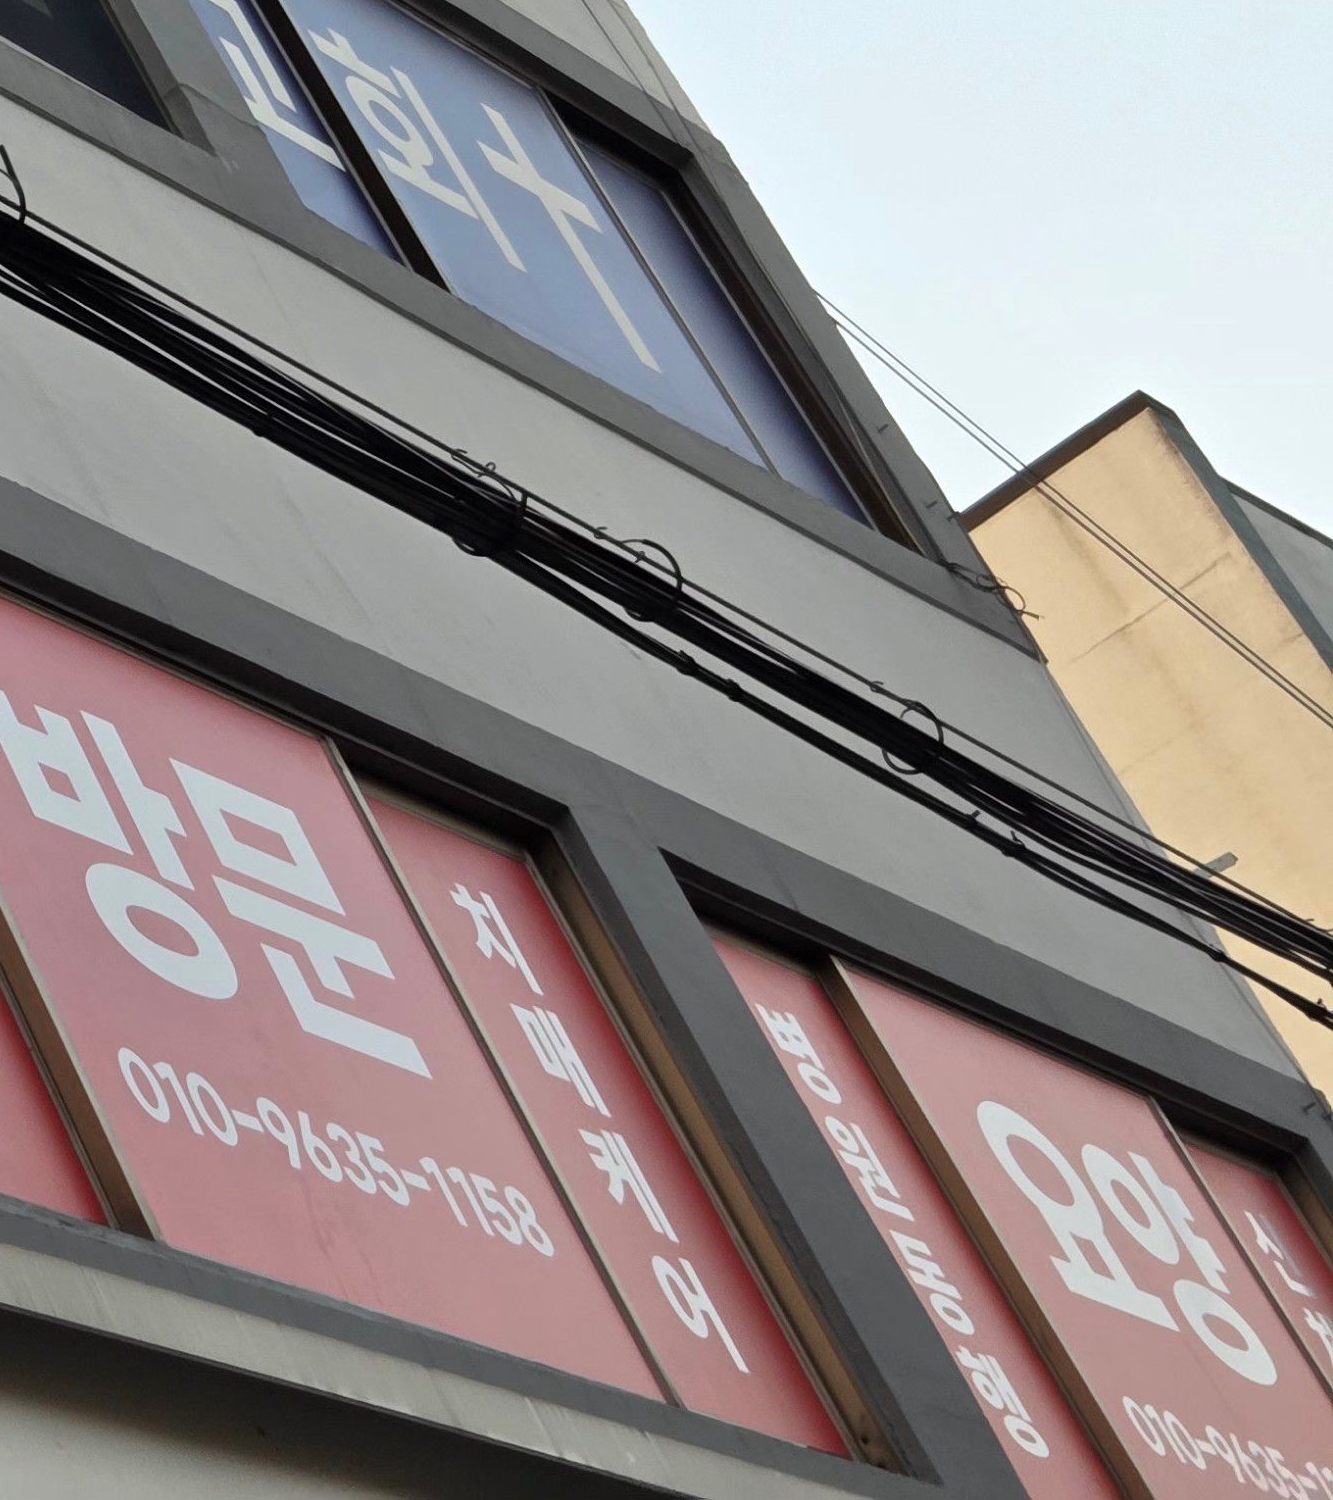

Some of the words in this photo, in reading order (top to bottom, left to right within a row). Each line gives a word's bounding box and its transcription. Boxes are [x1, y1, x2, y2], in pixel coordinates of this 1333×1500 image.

[118, 1047, 555, 1257] 010-9635-1158
[449, 883, 749, 1374] 치매케어
[754, 1003, 1050, 1458] 병원동행
[976, 1100, 1277, 1386] 요양
